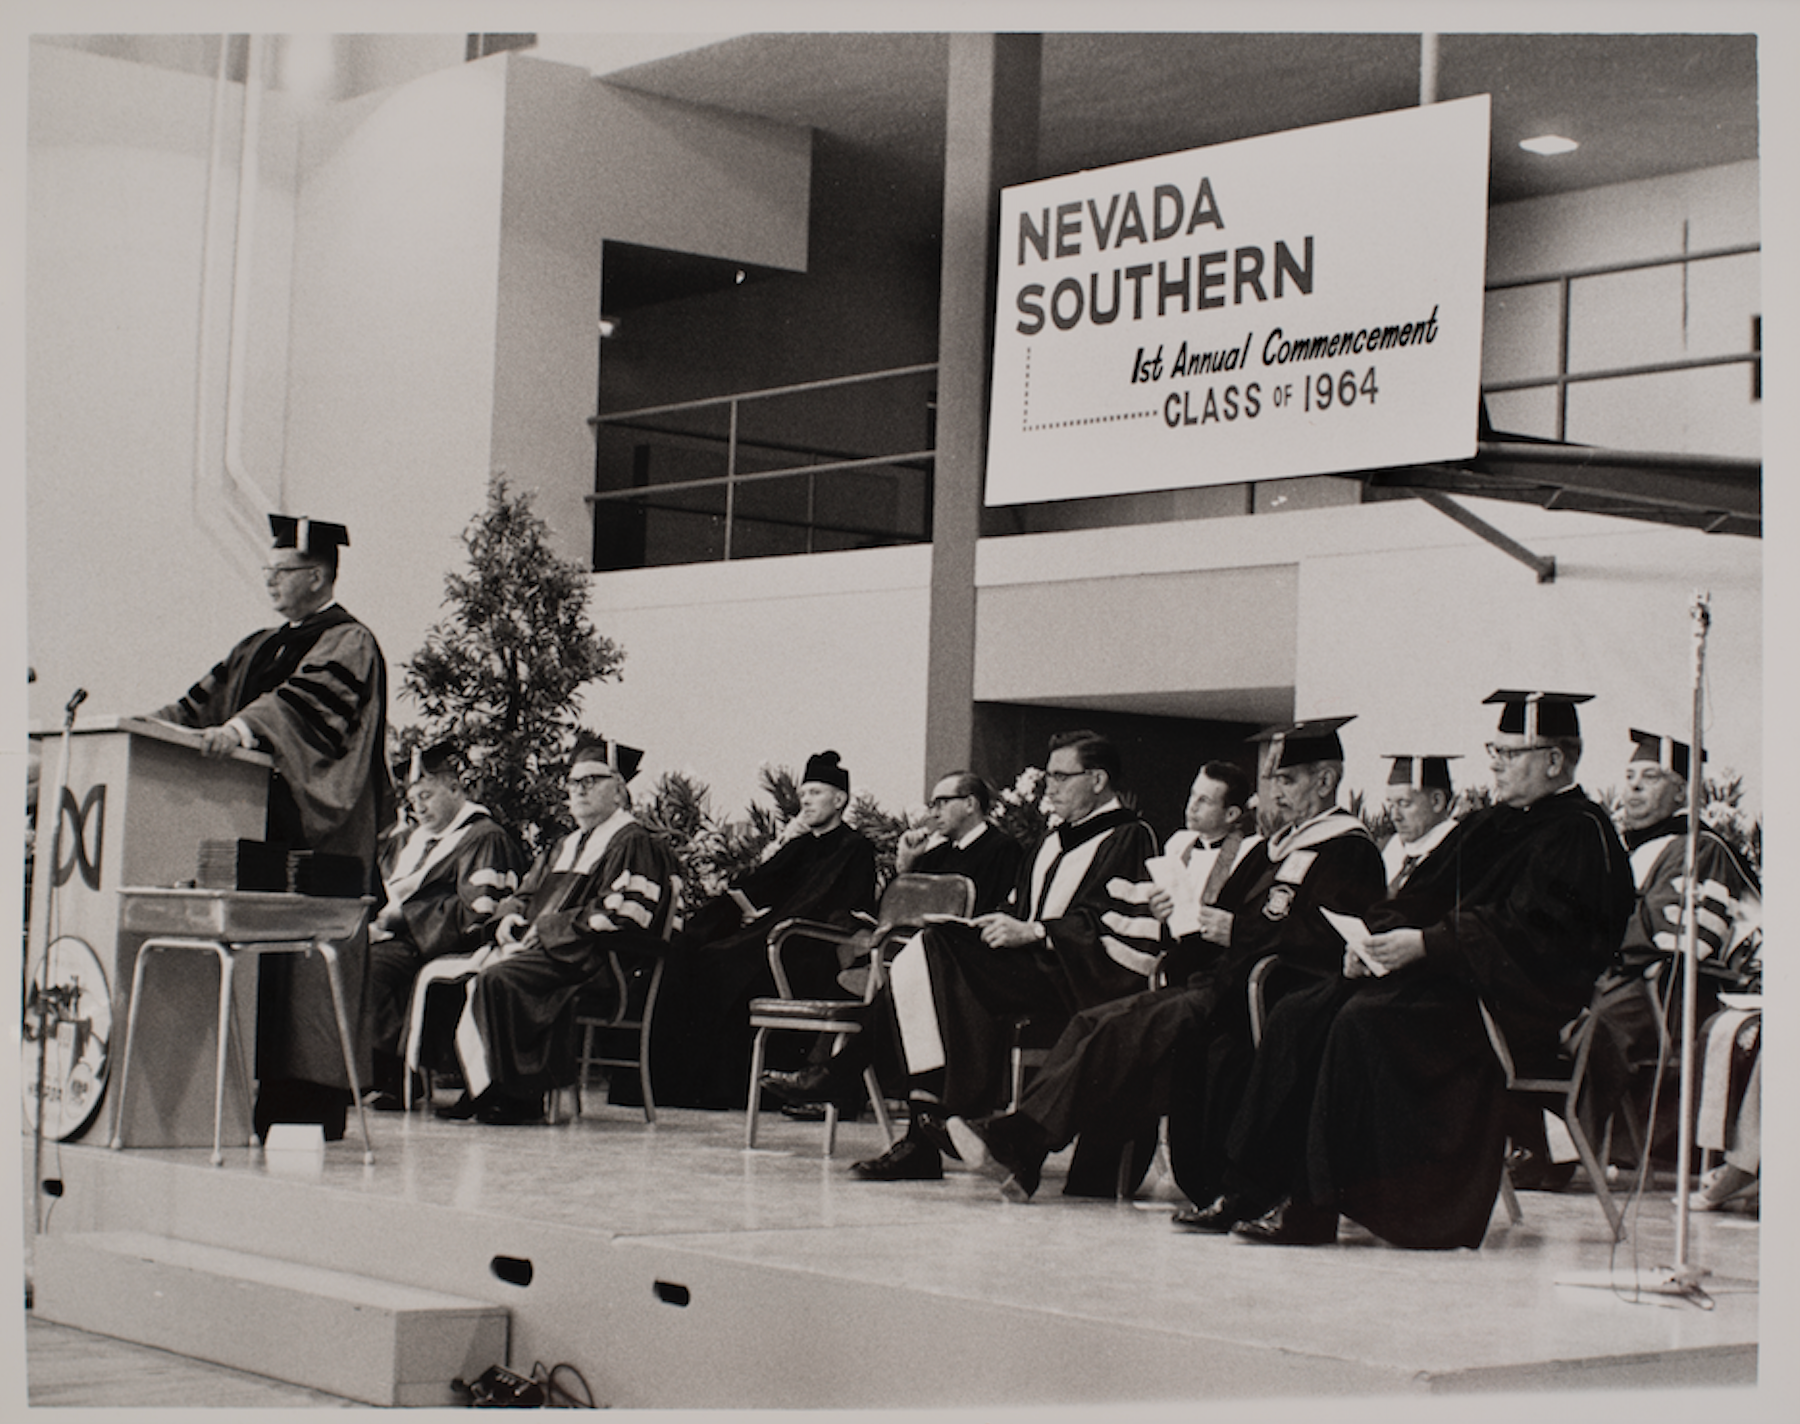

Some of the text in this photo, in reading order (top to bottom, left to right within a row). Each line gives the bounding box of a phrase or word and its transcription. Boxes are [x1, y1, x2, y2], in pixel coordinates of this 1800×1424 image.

[1018, 177, 1225, 266] NEVADA
[1016, 236, 1314, 336] SOUTHERN
[1131, 304, 1440, 384] 1st Annual Commencement
[1164, 366, 1380, 428] CLASS OF 1964
